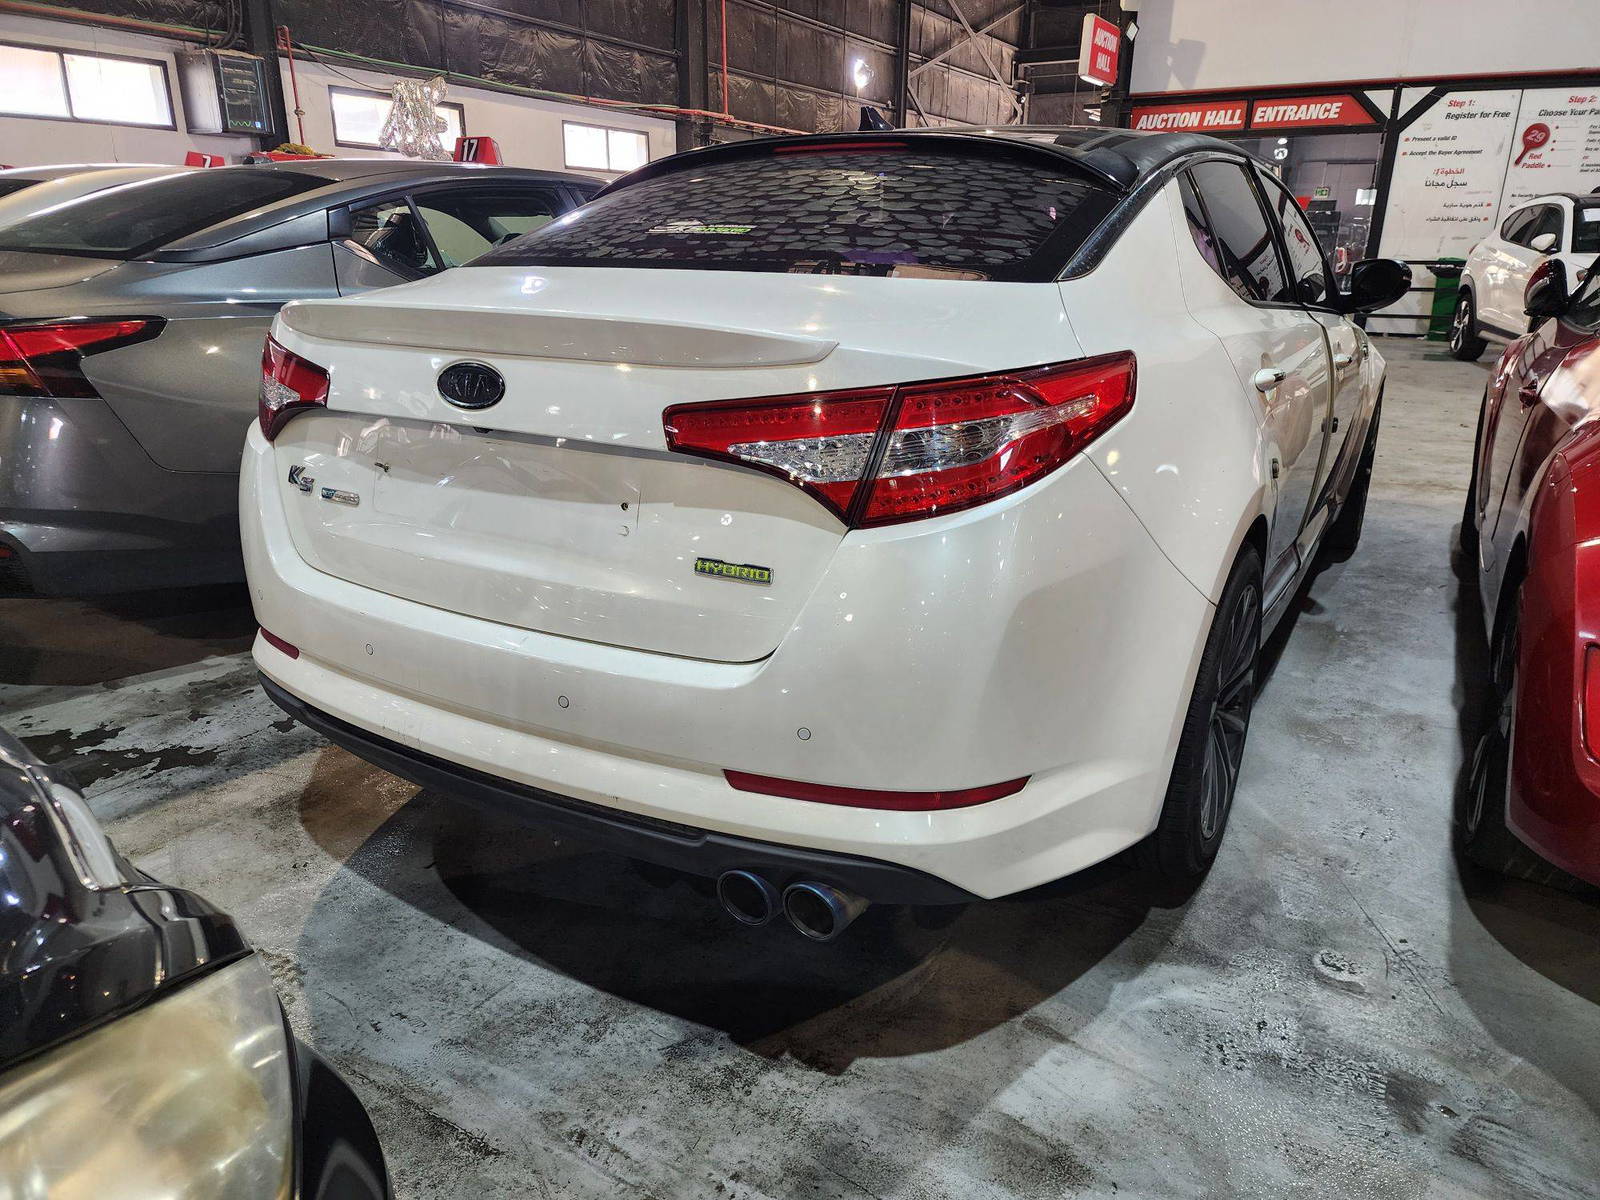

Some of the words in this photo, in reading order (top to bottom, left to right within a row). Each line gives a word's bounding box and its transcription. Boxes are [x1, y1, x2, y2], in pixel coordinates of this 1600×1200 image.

[1094, 27, 1118, 53] AUCTION
[1096, 52, 1110, 72] HALL
[1448, 100, 1466, 108] Step
[1569, 96, 1587, 104] Step
[1136, 112, 1201, 130] AUCTION
[1203, 109, 1242, 126] HALL
[1254, 102, 1343, 123] ENTRANCE
[1445, 111, 1478, 120] Register
[1480, 111, 1491, 119] for
[1493, 110, 1511, 118] Free
[1538, 109, 1567, 117] Choose
[1527, 130, 1546, 143] 29
[463, 138, 478, 162] 17
[202, 155, 212, 168] 7
[448, 372, 491, 398] KIA
[288, 465, 315, 495] K5
[696, 559, 769, 581] HYBRID
